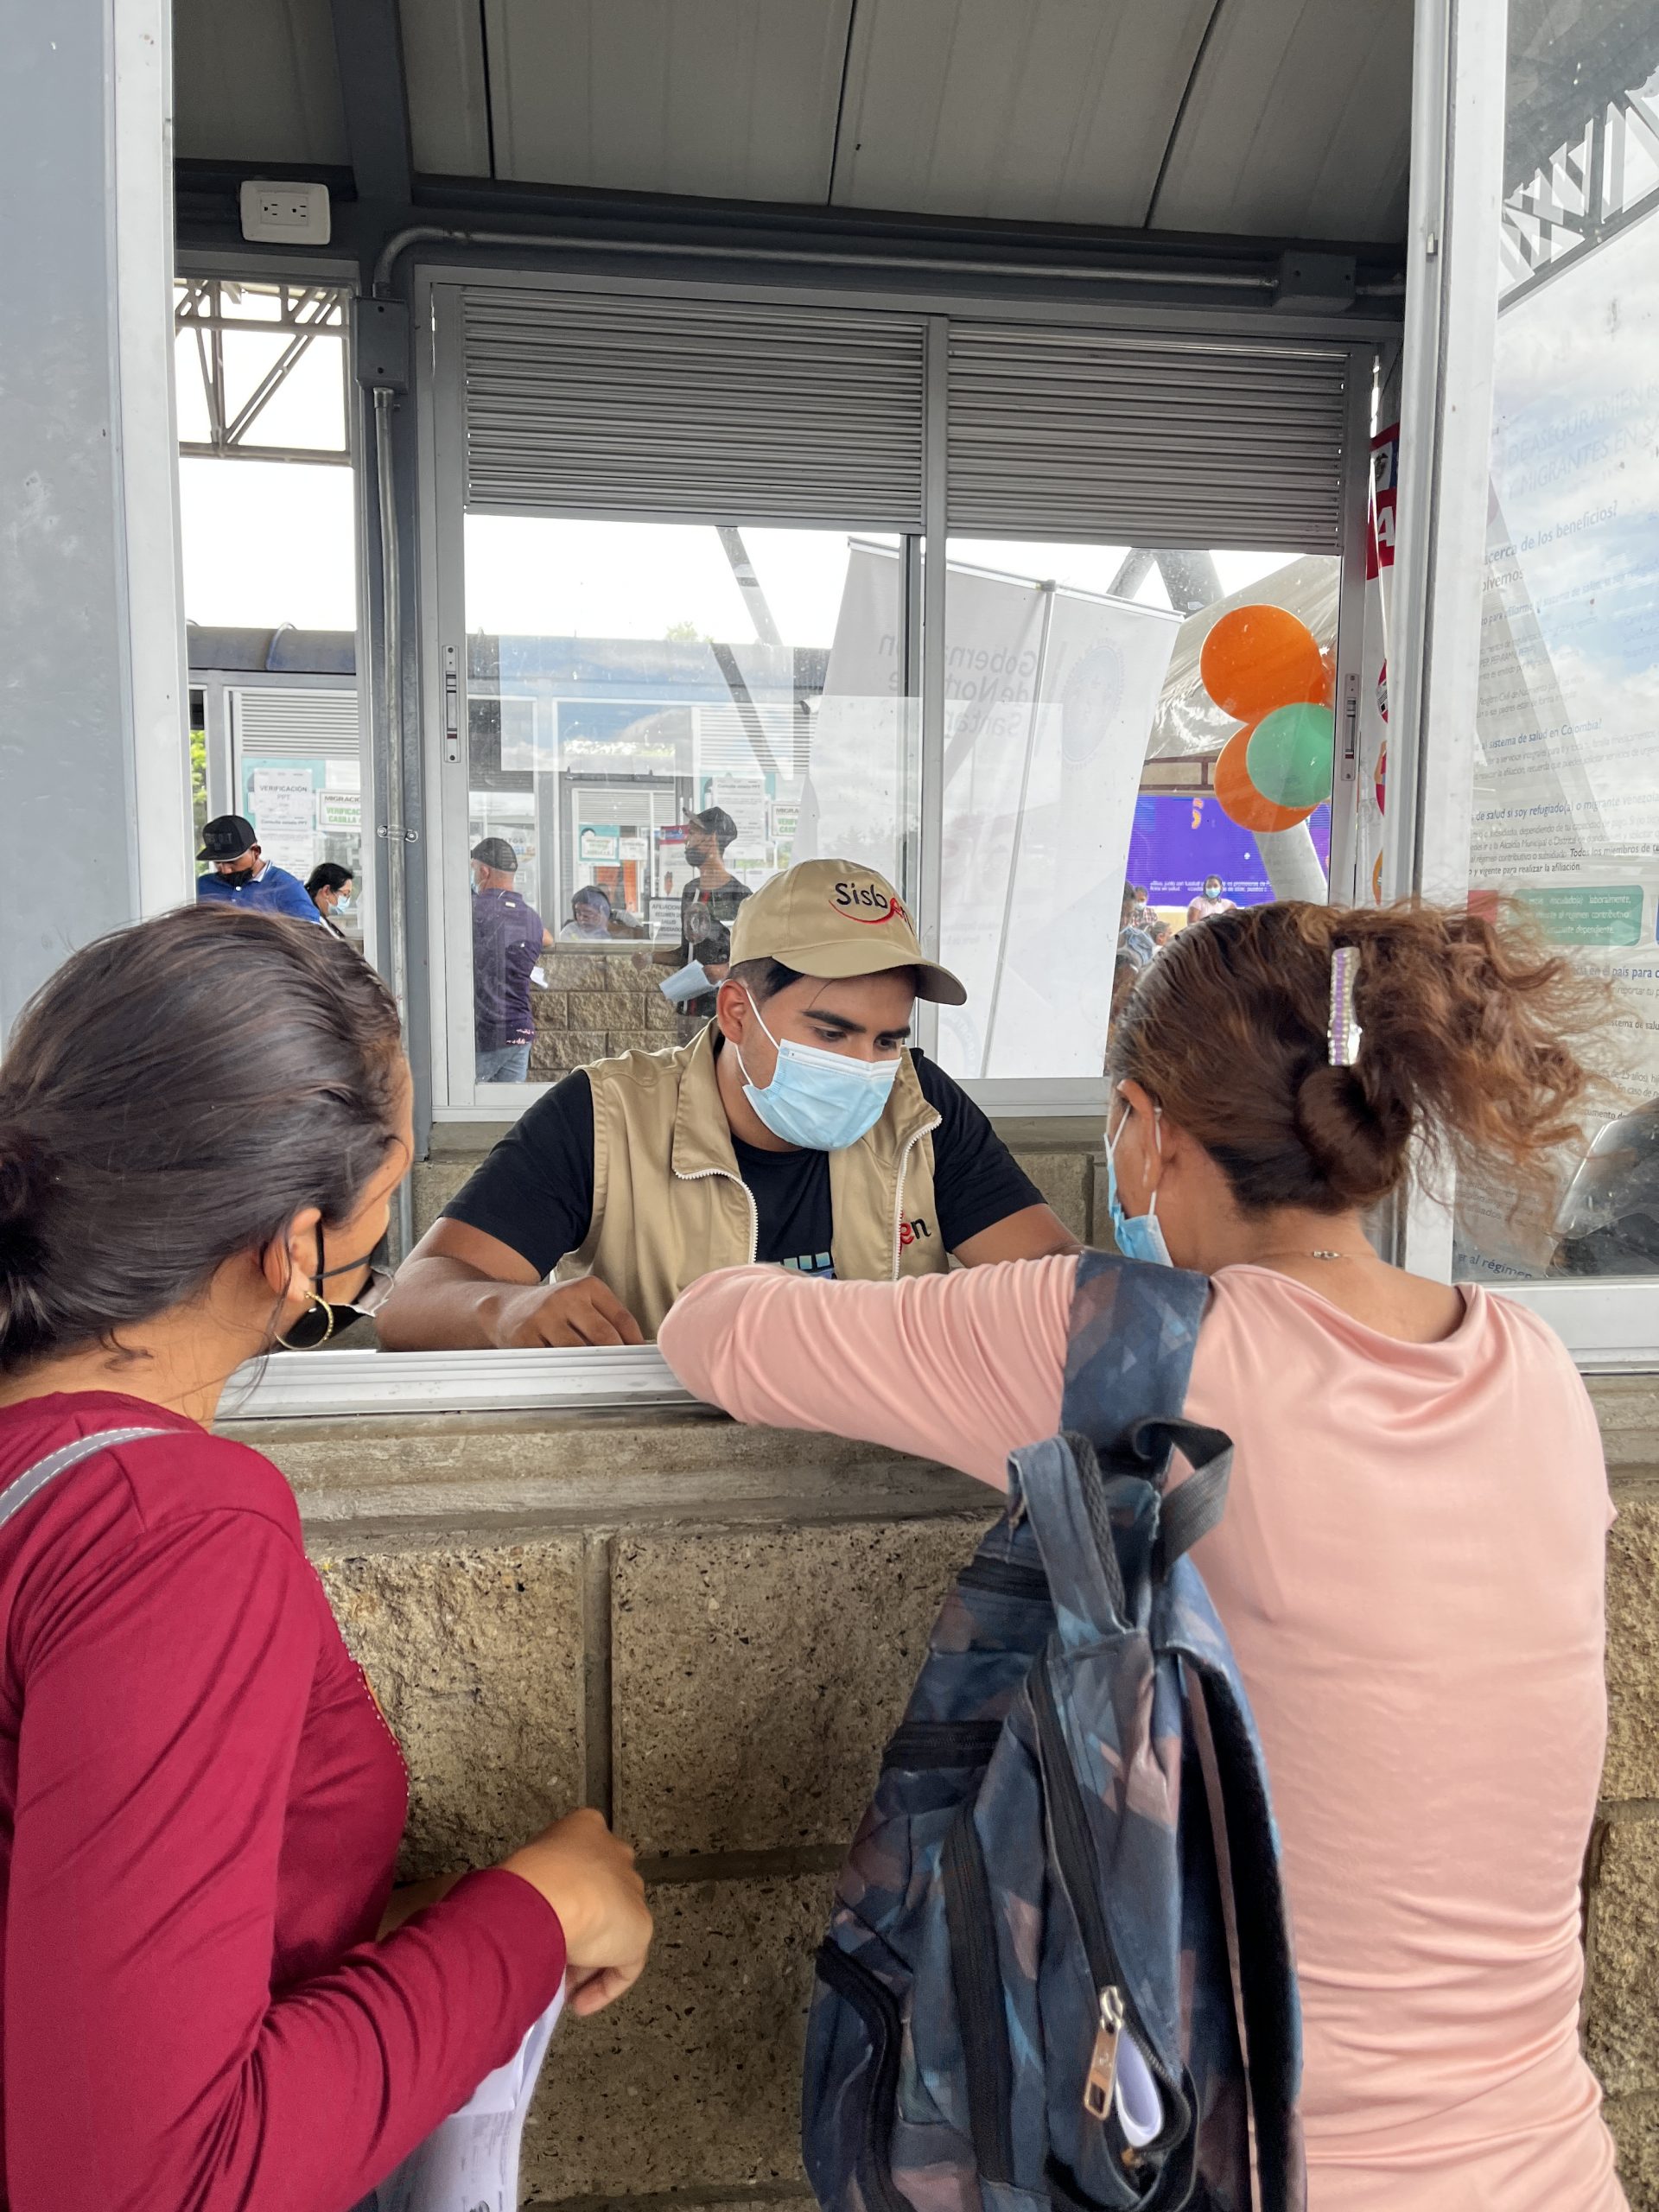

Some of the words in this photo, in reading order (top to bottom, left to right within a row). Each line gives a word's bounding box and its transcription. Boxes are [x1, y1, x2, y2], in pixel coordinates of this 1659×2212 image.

[1521, 536, 1535, 552] de
[1538, 531, 1553, 546] los
[1555, 499, 1618, 539] beneficios?
[1488, 736, 1516, 749] sistema
[1517, 732, 1528, 744] de
[1528, 728, 1548, 742] salud
[1548, 728, 1559, 739] en
[1476, 810, 1485, 821] de
[1486, 808, 1505, 820] salud
[1515, 807, 1528, 820] soy
[1604, 843, 1640, 855] miembros
[1641, 842, 1650, 853] de
[1473, 868, 1479, 878] y
[1479, 868, 1502, 878] vigente
[1503, 867, 1517, 876] para
[1518, 864, 1543, 874] realizar
[1544, 864, 1550, 873] la
[1611, 965, 1630, 977] país
[1631, 968, 1652, 980] para
[1627, 1087, 1643, 1096] caso
[1643, 1088, 1652, 1097] de
[1470, 1254, 1480, 1265] al
